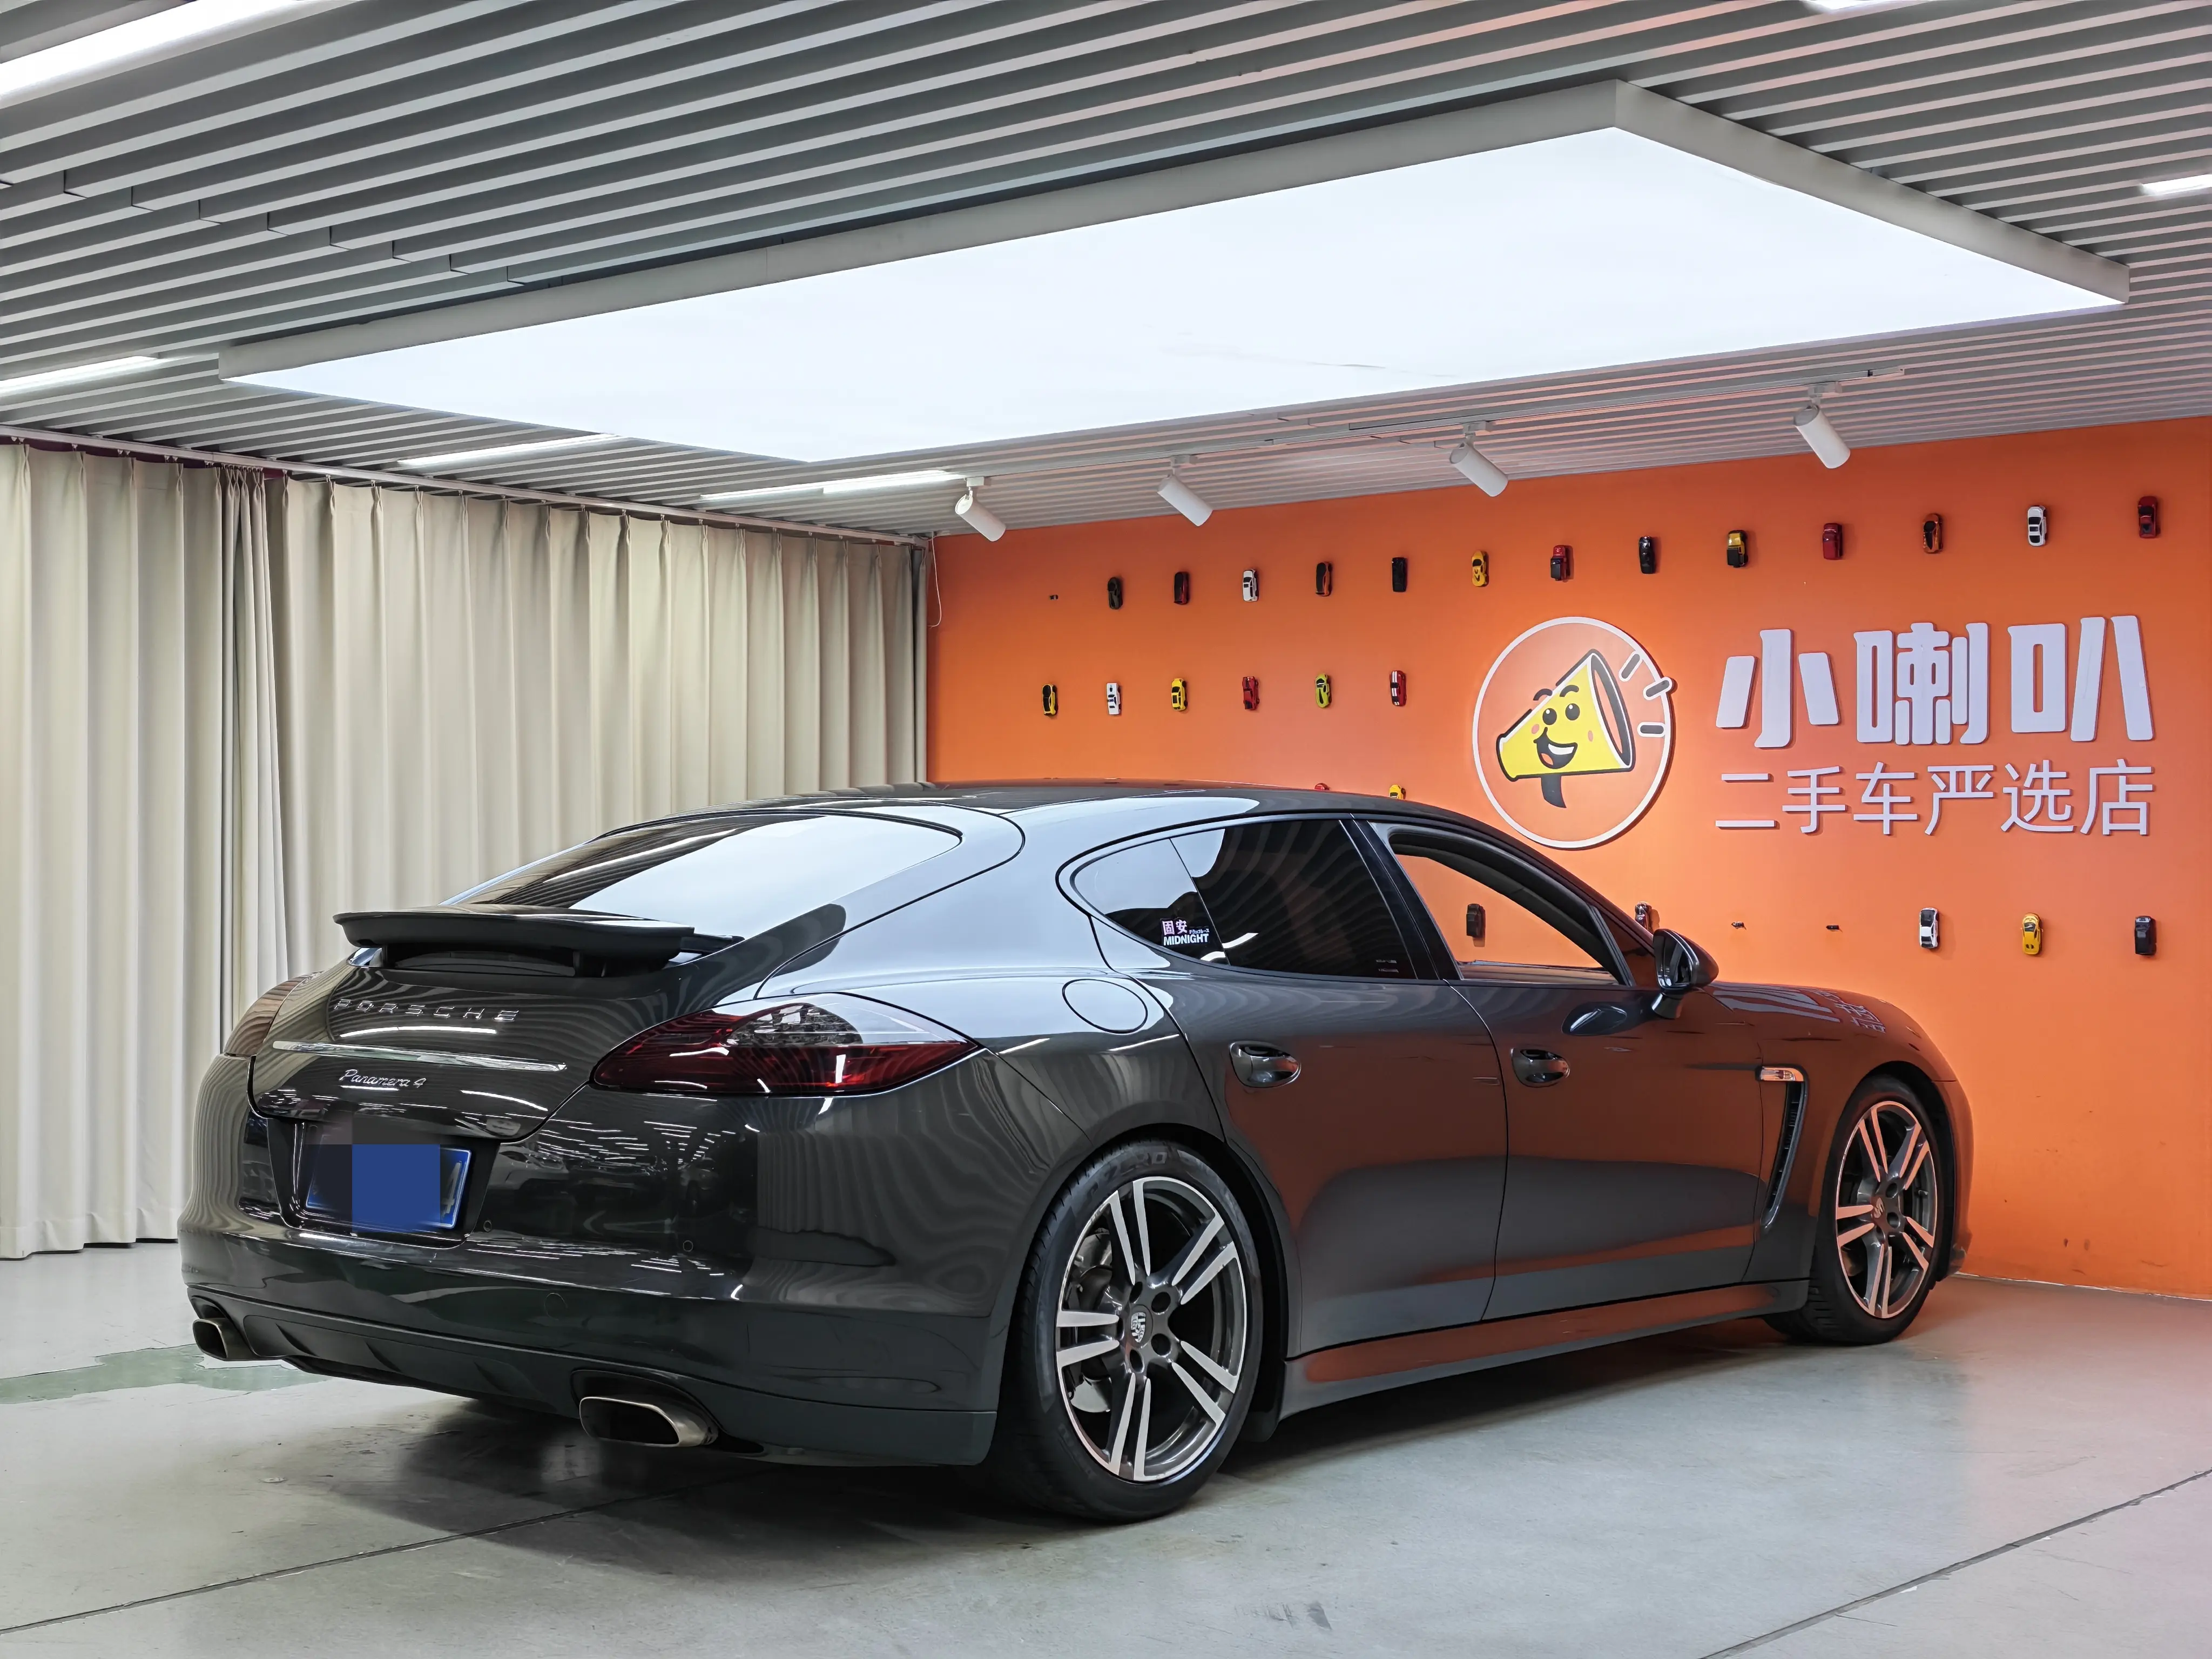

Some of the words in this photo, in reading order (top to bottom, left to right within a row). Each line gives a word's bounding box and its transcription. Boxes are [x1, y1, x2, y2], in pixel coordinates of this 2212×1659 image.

[1716, 615, 2154, 748] 小喇叭
[1715, 758, 2154, 836] 二手车严选店
[1162, 920, 1188, 935] 固安
[1163, 933, 1209, 946] MIDNIGHT
[334, 998, 520, 1022] PORSCHE
[339, 1069, 410, 1087] Panamera
[413, 1077, 427, 1088] 4
